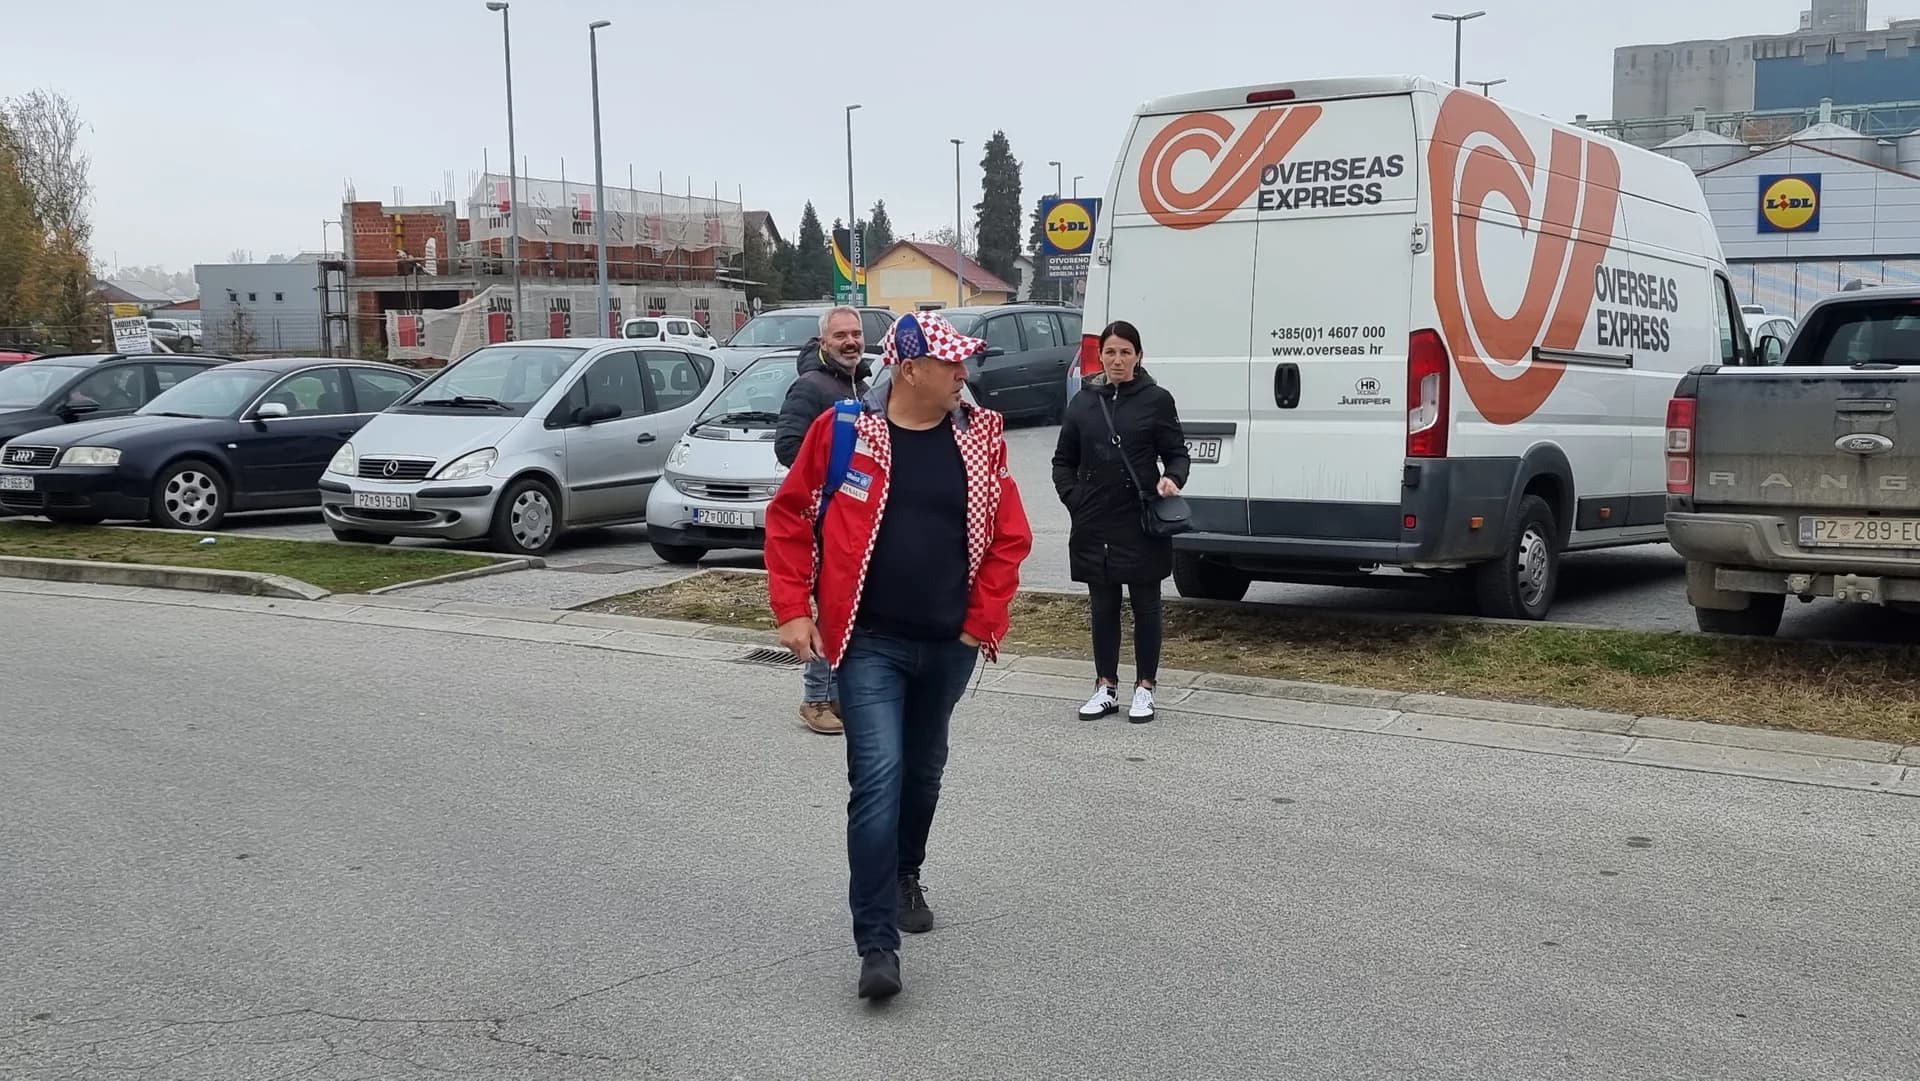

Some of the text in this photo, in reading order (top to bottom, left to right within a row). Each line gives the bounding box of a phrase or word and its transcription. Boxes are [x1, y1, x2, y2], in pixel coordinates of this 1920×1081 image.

[1261, 154, 1404, 186] OVERSEAS
[1258, 182, 1382, 211] EXPRESS
[1595, 264, 1679, 313] OVERSEAS
[1270, 326, 1386, 342] +385(0)1 4607 000
[1597, 309, 1670, 352] EXPRESS
[1272, 346, 1365, 356] www.overseas
[1360, 381, 1376, 389] HR
[1850, 440, 1873, 449] Ford
[360, 494, 408, 508] PZ 919-DA
[699, 511, 745, 525] PZ 000-L
[1815, 521, 1838, 539] PZ
